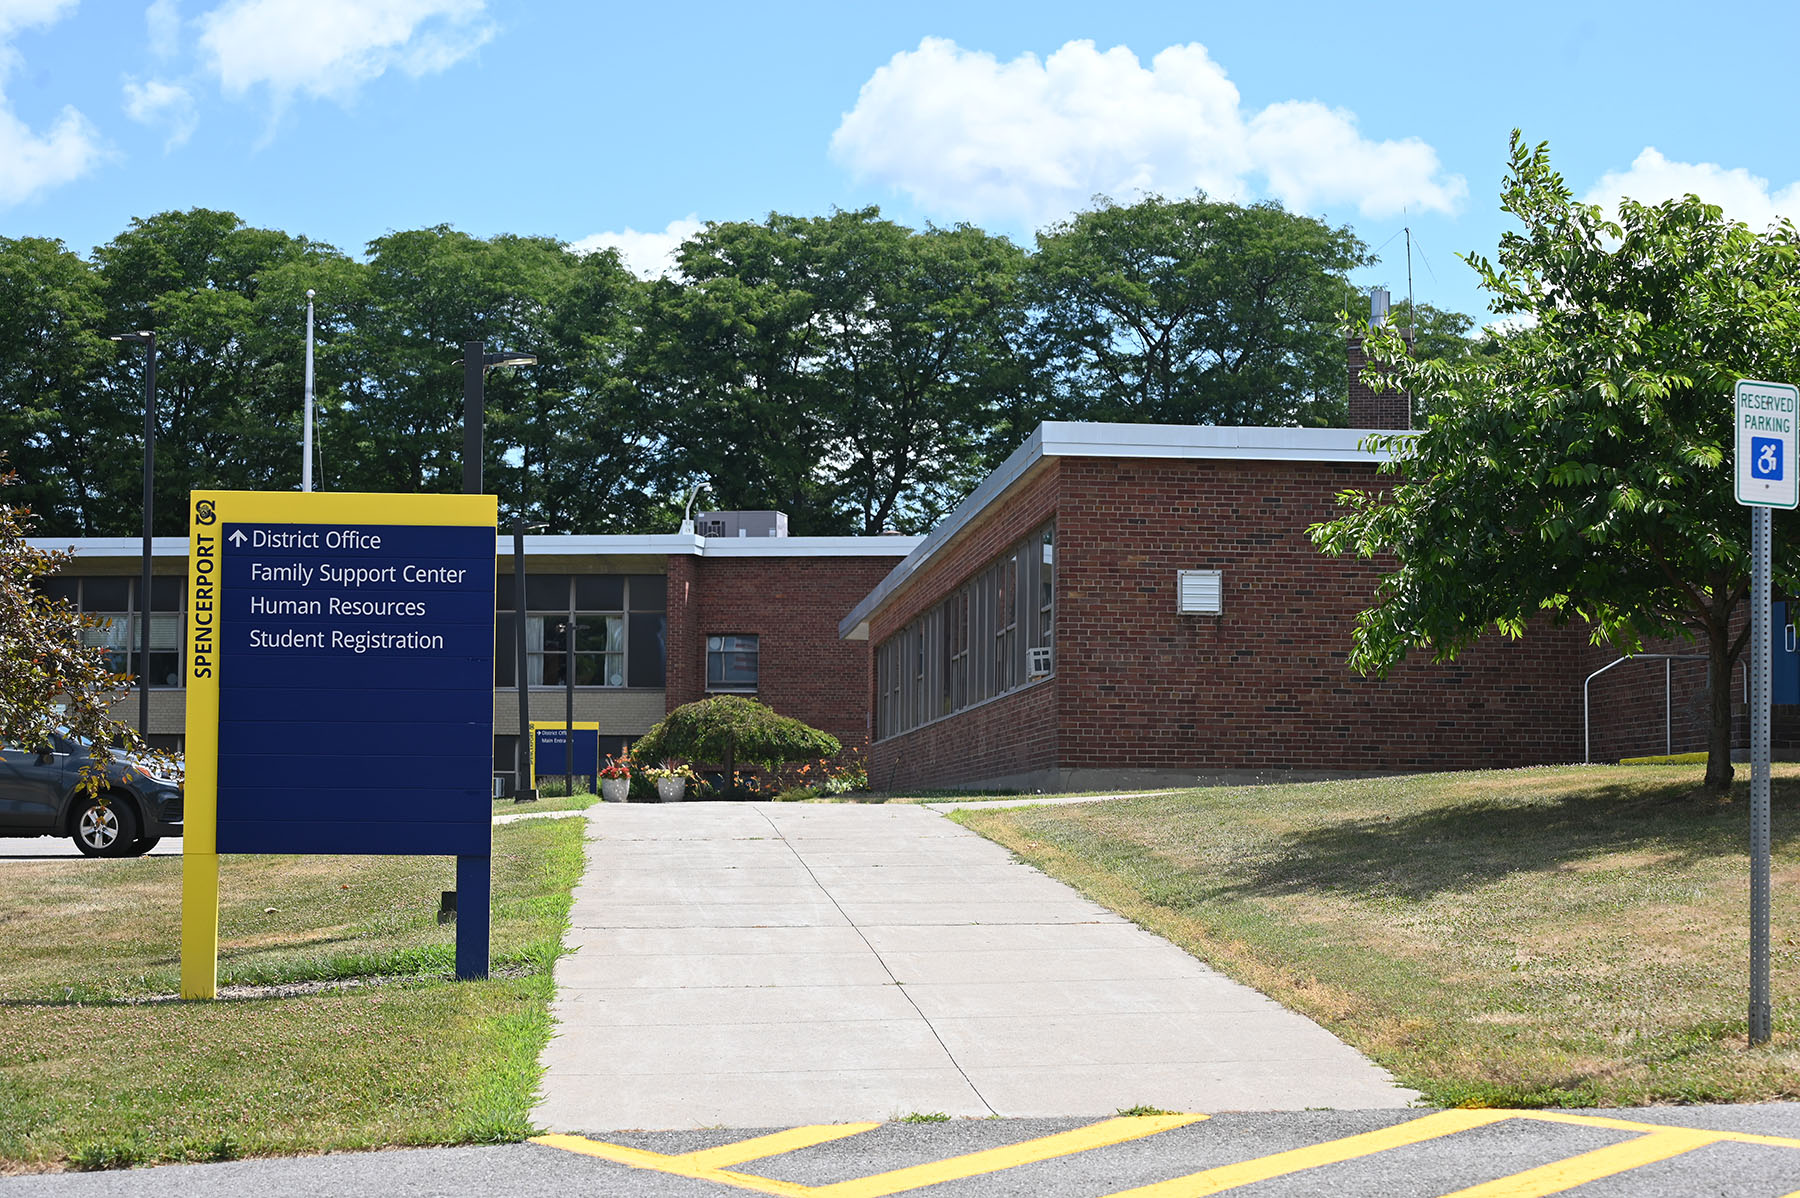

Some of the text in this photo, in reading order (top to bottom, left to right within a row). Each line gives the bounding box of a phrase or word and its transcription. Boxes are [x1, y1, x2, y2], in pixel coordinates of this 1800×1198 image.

[1741, 393, 1793, 412] RESERVED
[1744, 414, 1790, 433] PARKING
[253, 530, 382, 550] District Office
[251, 563, 467, 587] Family Support Center
[194, 533, 215, 679] SPENCERPORT
[251, 596, 426, 616] Human Resources
[249, 629, 444, 653] Student Registration
